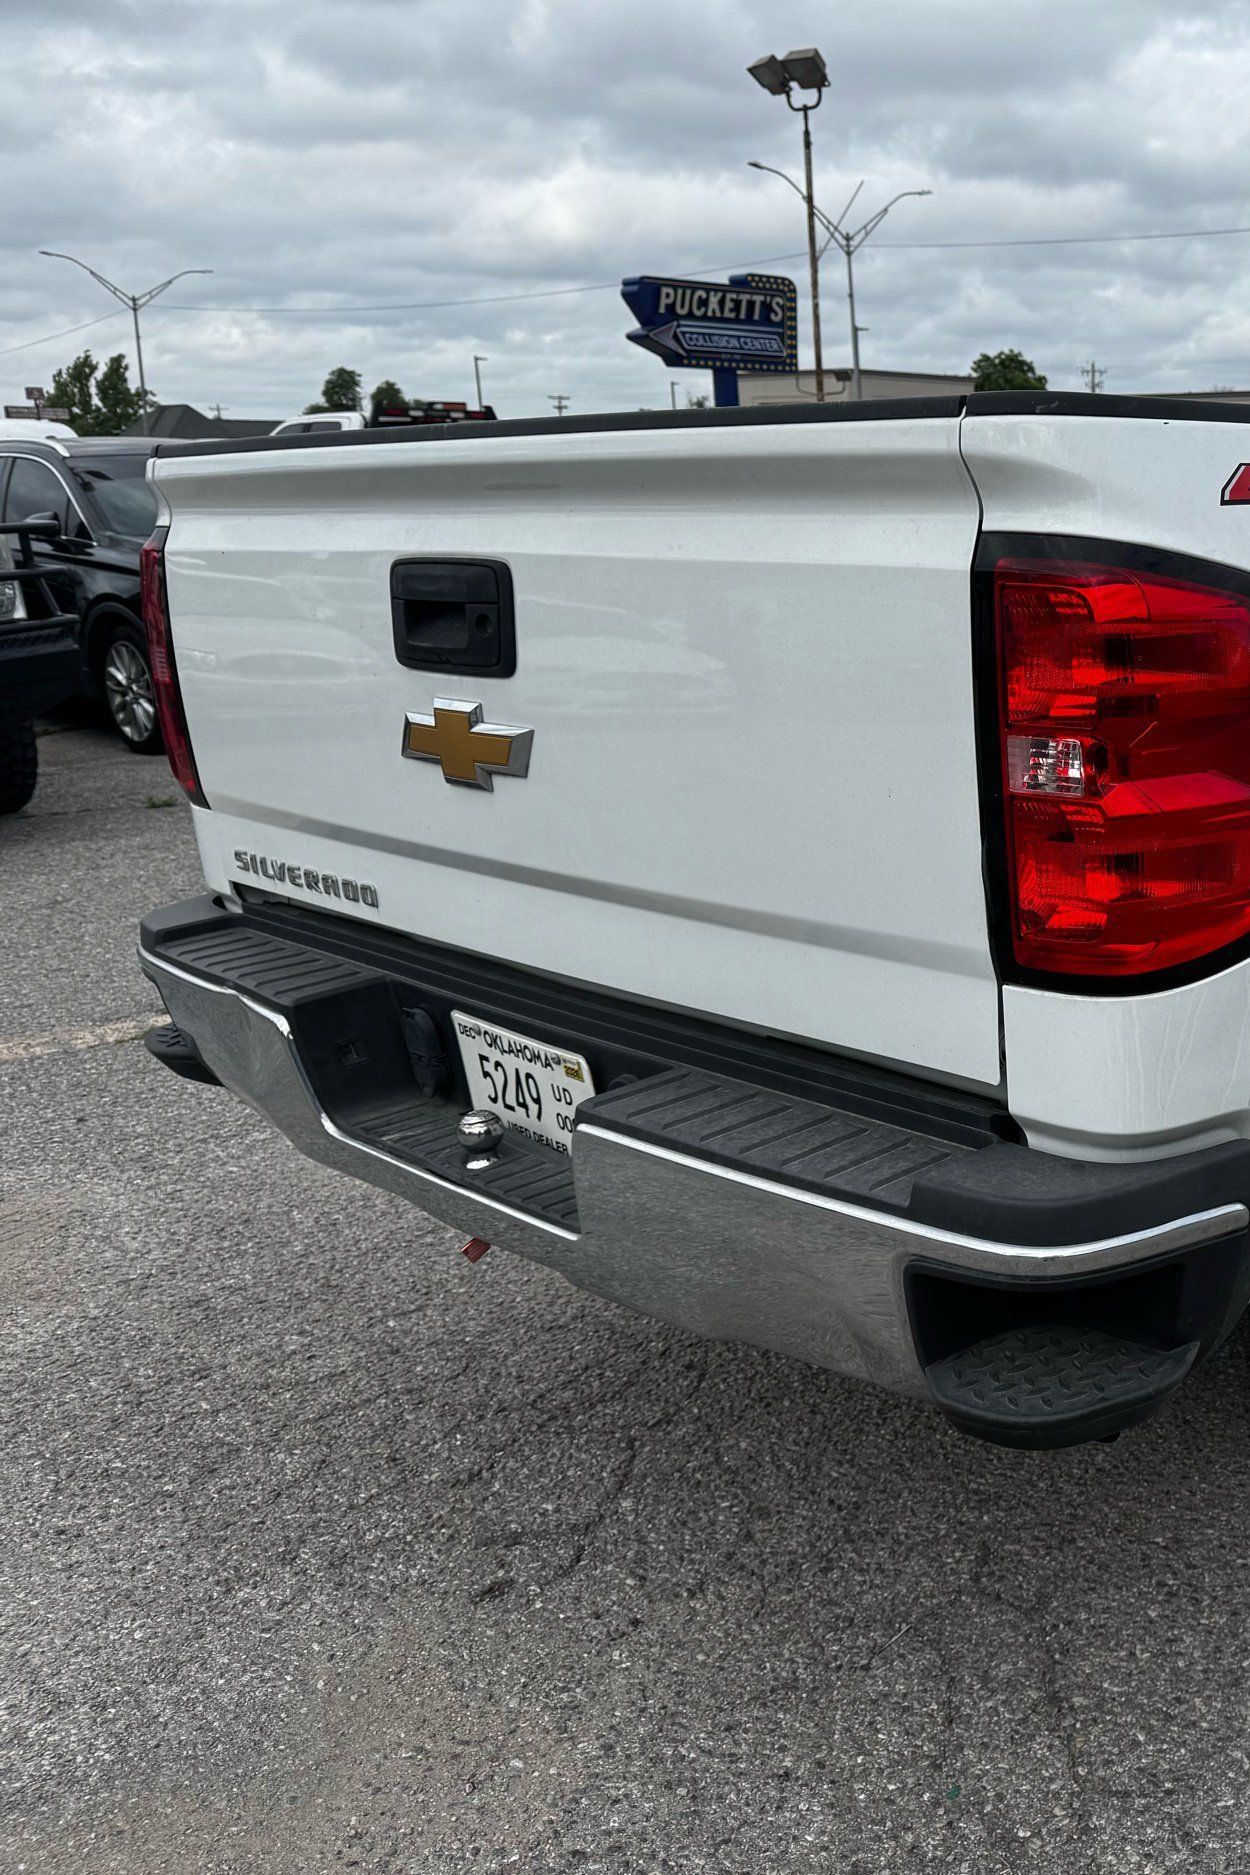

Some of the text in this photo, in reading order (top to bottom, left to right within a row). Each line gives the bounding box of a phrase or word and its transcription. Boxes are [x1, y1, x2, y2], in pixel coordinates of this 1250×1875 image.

[658, 286, 784, 323] PUCKETT'S
[685, 333, 781, 352] COLLISION CENTER
[233, 849, 379, 909] SILVERADO
[457, 1022, 555, 1072] DEC OKLAHOMA
[477, 1053, 543, 1122] 5249
[551, 1083, 573, 1106] UD
[507, 1120, 569, 1157] USED DEALER
[556, 1112, 576, 1134] 00
